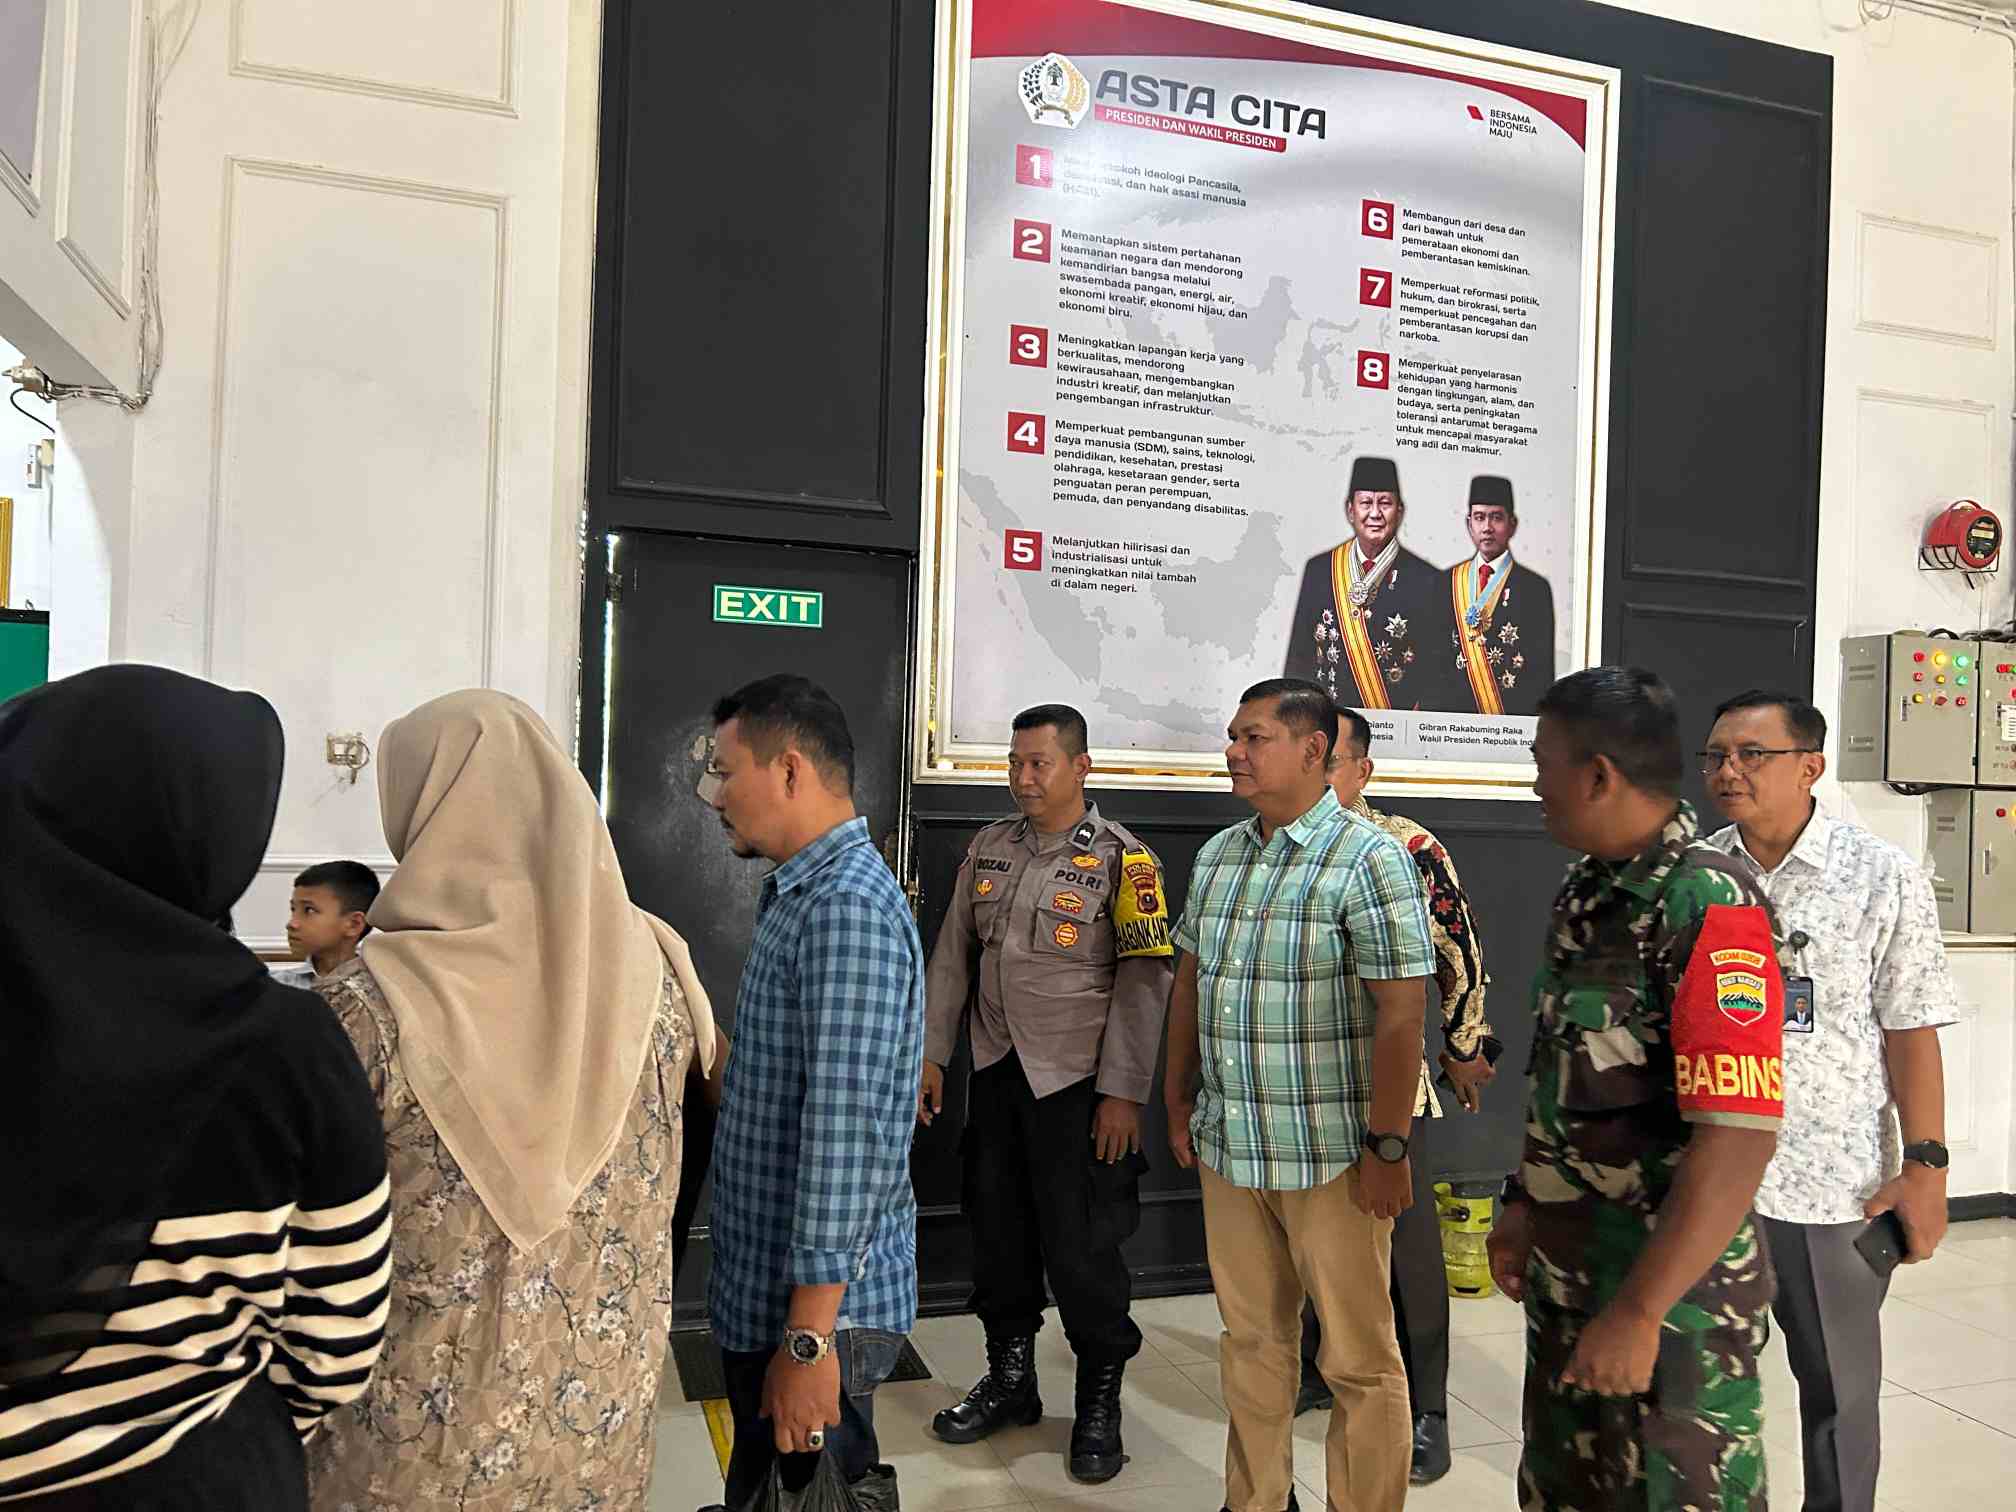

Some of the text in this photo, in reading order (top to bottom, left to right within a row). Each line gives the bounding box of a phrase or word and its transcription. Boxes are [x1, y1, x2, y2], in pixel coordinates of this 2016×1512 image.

[1096, 69, 1326, 139] ASTA CITA
[1490, 109, 1531, 124] BERSAMA
[1105, 108, 1277, 149] PRESIDEN DAN WAKIL PRESIDEN
[1489, 118, 1538, 135] INDONESIA
[1489, 128, 1513, 139] MAJU
[1029, 154, 1041, 180] 1
[1368, 207, 1388, 232] 6
[1402, 208, 1526, 237] Membangun dari desa dan
[1402, 222, 1484, 243] dari bawah untuk
[1021, 228, 1044, 255] 2
[1061, 228, 1241, 264] Memantapkan sistem pertahanan
[1401, 236, 1519, 262] pemerataan ekonomi dan
[1059, 256, 1211, 287] kemandirian bangsa melalui
[1060, 242, 1243, 280] keamanan negara dan mendorong
[1401, 249, 1531, 276] pemberantasan kemiskinan.
[1059, 272, 1235, 305] swasembada pangan, energi, air,
[1366, 275, 1386, 300] 7
[1400, 276, 1540, 307] Memperkuat reformasi politik,
[1058, 285, 1248, 320] ekonomi kreatif, ekonomi hijau, dan
[1058, 300, 1133, 319] ekonomi biru.
[1400, 289, 1527, 317] hukum, dan birokrasi, serta
[1399, 304, 1537, 331] memperkuat pencegahan dan
[1399, 317, 1529, 343] pemberantasan korupsi dan
[1017, 333, 1041, 360] 3
[1399, 330, 1441, 343] narkoba.
[1057, 333, 1245, 367] Meningkatkan lapangan kerja yang
[1057, 347, 1185, 373] berkualitas, mendorong
[1056, 361, 1235, 391] kewirausahaan, mengembangkan
[1363, 357, 1384, 383] 8
[1397, 370, 1518, 394] kehidupan yang harmonis
[1398, 357, 1522, 382] Memperkuat penyelarasan
[1056, 375, 1231, 405] industri kreatif, dan melanjutkan
[1397, 384, 1535, 409] dengan lingkungan, alam, dan
[1055, 391, 1214, 416] pengembangan infrastruktur.
[1396, 396, 1521, 420] budaya, serta peningkatan
[1014, 420, 1039, 447] 4
[1055, 419, 1246, 448] Memperkuat pembangunan sumber
[1396, 409, 1538, 435] toleransi antarumat beragama
[1395, 437, 1502, 456] yang adil dan makmur.
[1396, 424, 1529, 447] untuk mencapai masyarakat
[1054, 434, 1256, 464] daya manusia (SDM), sains, teknologi,
[1054, 449, 1223, 473] pendidikan, kesehatan, prestasi
[1053, 462, 1240, 488] olahraga, kesetaraan gender, serta
[1053, 477, 1212, 501] penguatan peran perempuan,
[1052, 491, 1249, 516] pemuda, dan penyandang disabilitas.
[1012, 537, 1035, 563] 5
[1051, 549, 1163, 568] industrialisasi untuk
[1052, 535, 1191, 556] Melanjutkan hilirisasi dan
[1050, 577, 1138, 594] di dalam negeri.
[1051, 565, 1197, 584] meningkatkan nilai tambah
[721, 591, 817, 622] EXIT
[1054, 869, 1103, 891] POLRI
